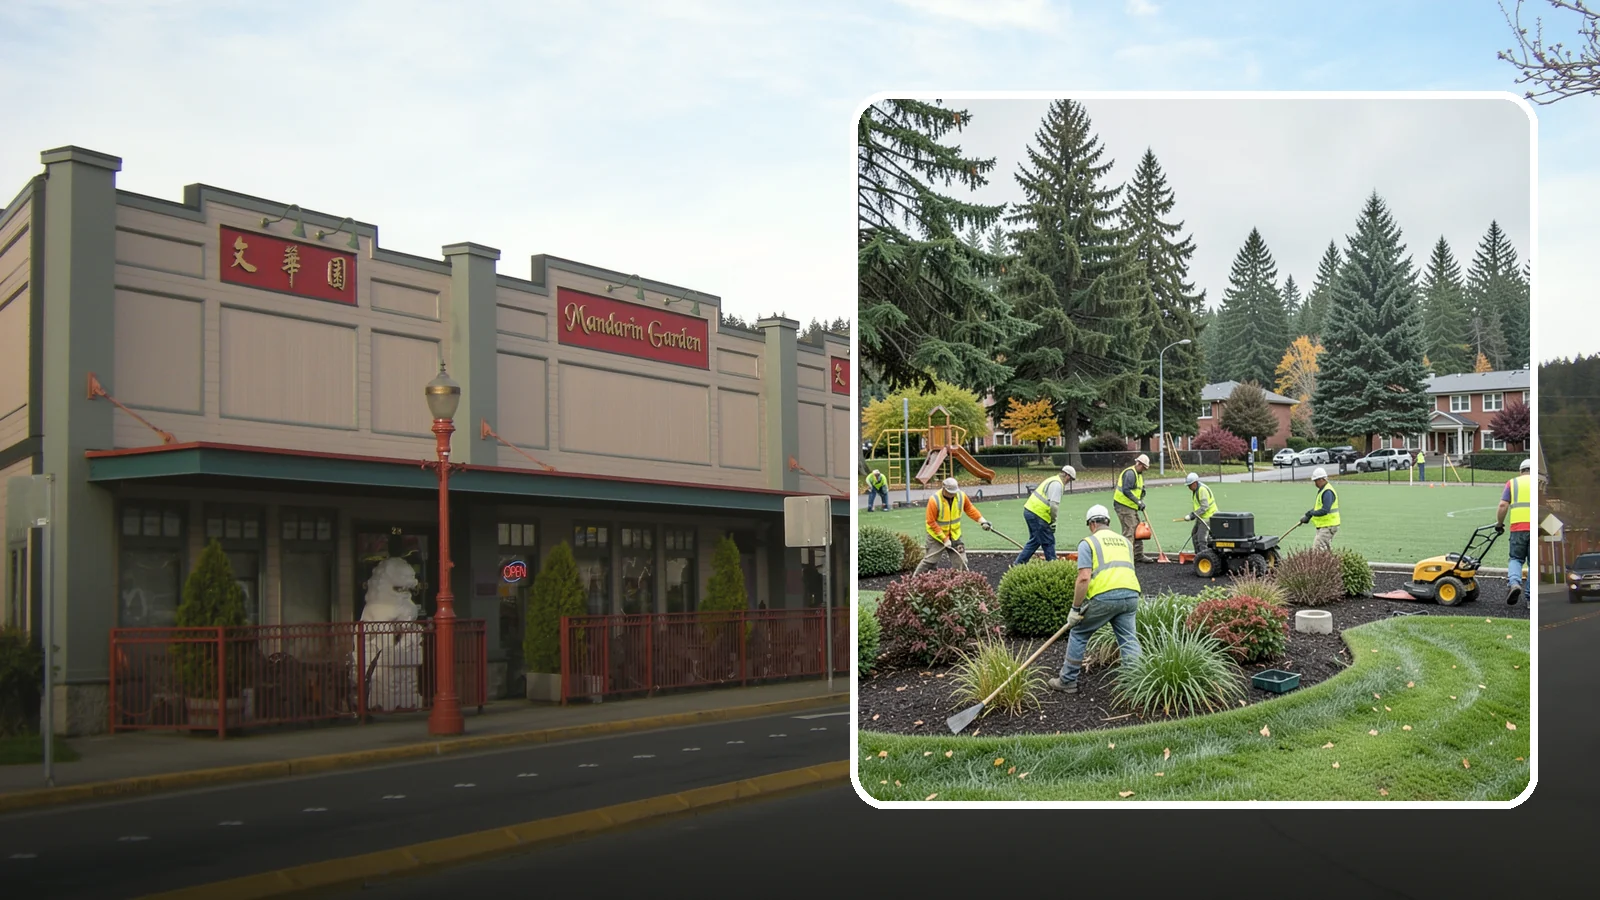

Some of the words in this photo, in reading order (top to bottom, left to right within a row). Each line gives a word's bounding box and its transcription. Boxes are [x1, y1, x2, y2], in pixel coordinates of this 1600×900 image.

[231, 235, 346, 291] 文華園
[564, 302, 644, 341] Mandarin
[648, 320, 701, 352] Garden
[503, 565, 527, 578] OPEN
